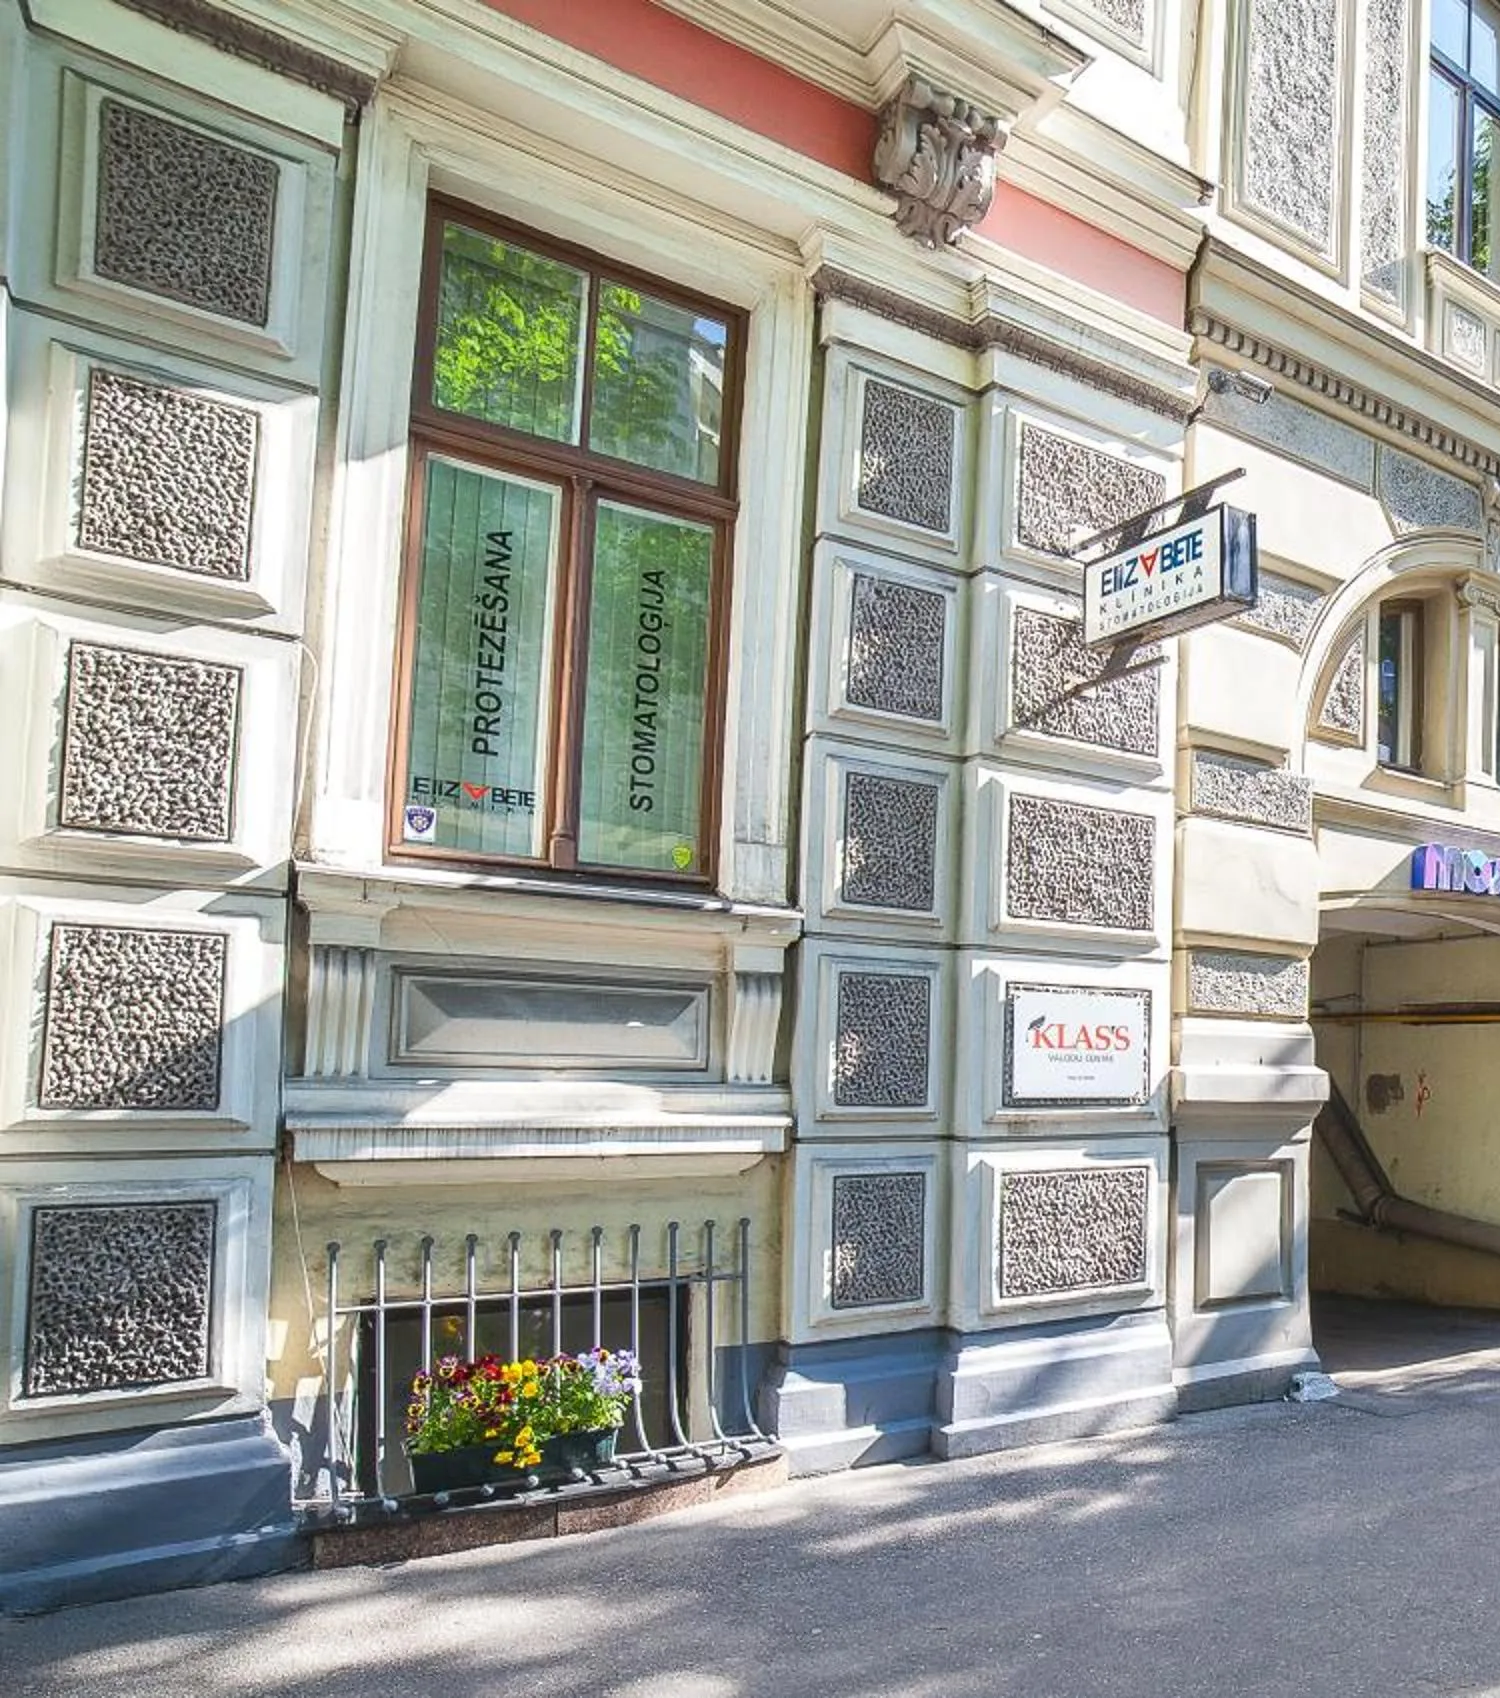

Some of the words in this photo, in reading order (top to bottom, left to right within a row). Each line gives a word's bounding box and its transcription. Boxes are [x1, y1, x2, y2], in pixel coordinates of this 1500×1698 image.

[1100, 565, 1203, 614] KLINIKA
[472, 530, 513, 757] PROTEZĒŠANA
[630, 569, 672, 813] STOMATOLOĢIJA
[411, 794, 535, 815] NIKA
[1032, 1023, 1131, 1051] KLAS'S
